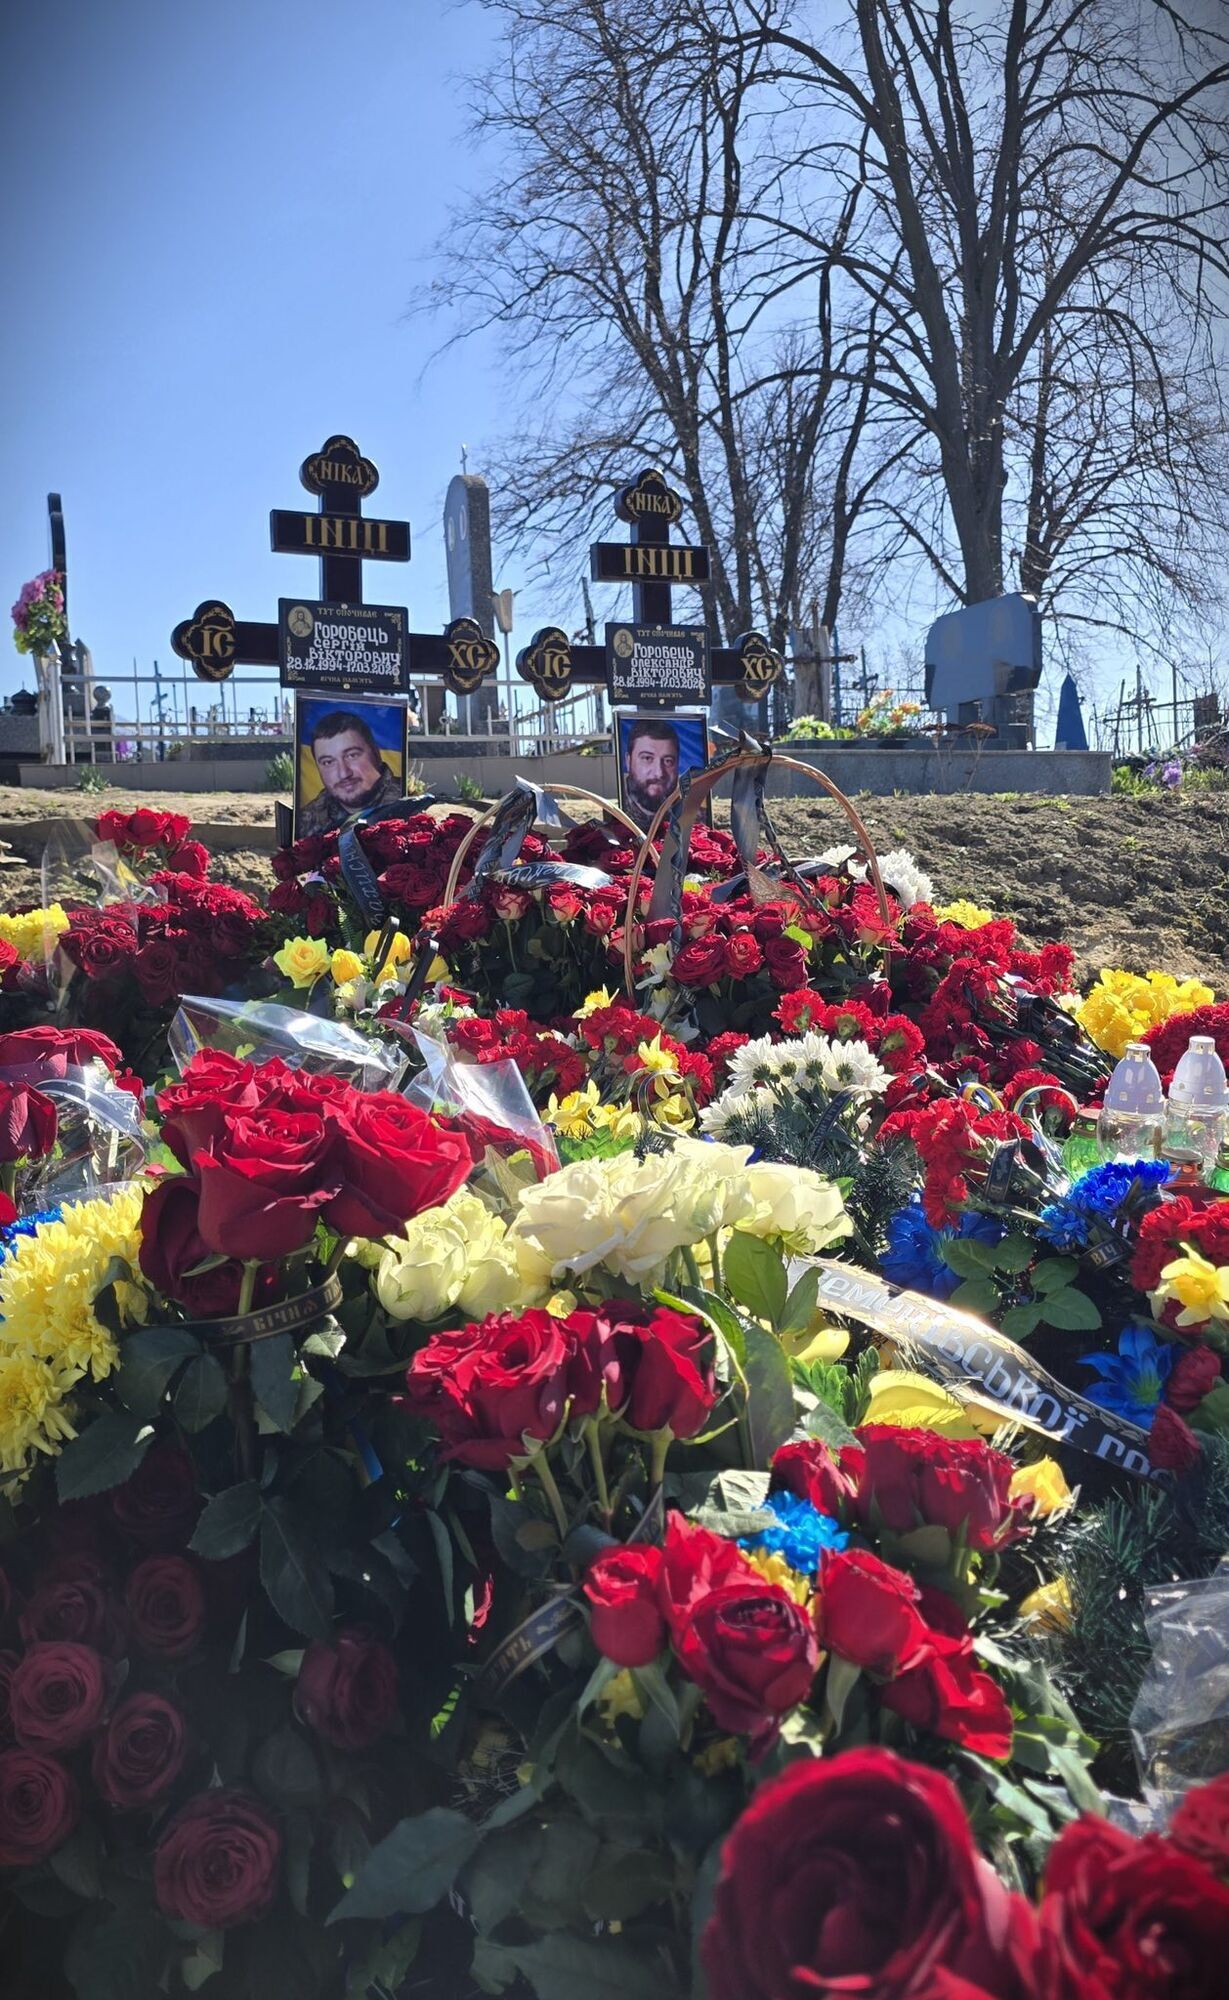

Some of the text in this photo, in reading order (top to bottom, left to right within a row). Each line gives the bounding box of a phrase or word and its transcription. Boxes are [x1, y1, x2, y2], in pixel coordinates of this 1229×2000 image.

[320, 460, 364, 486] НІКА
[636, 493, 672, 514] НІКА
[818, 1267, 1089, 1443] еменівської
